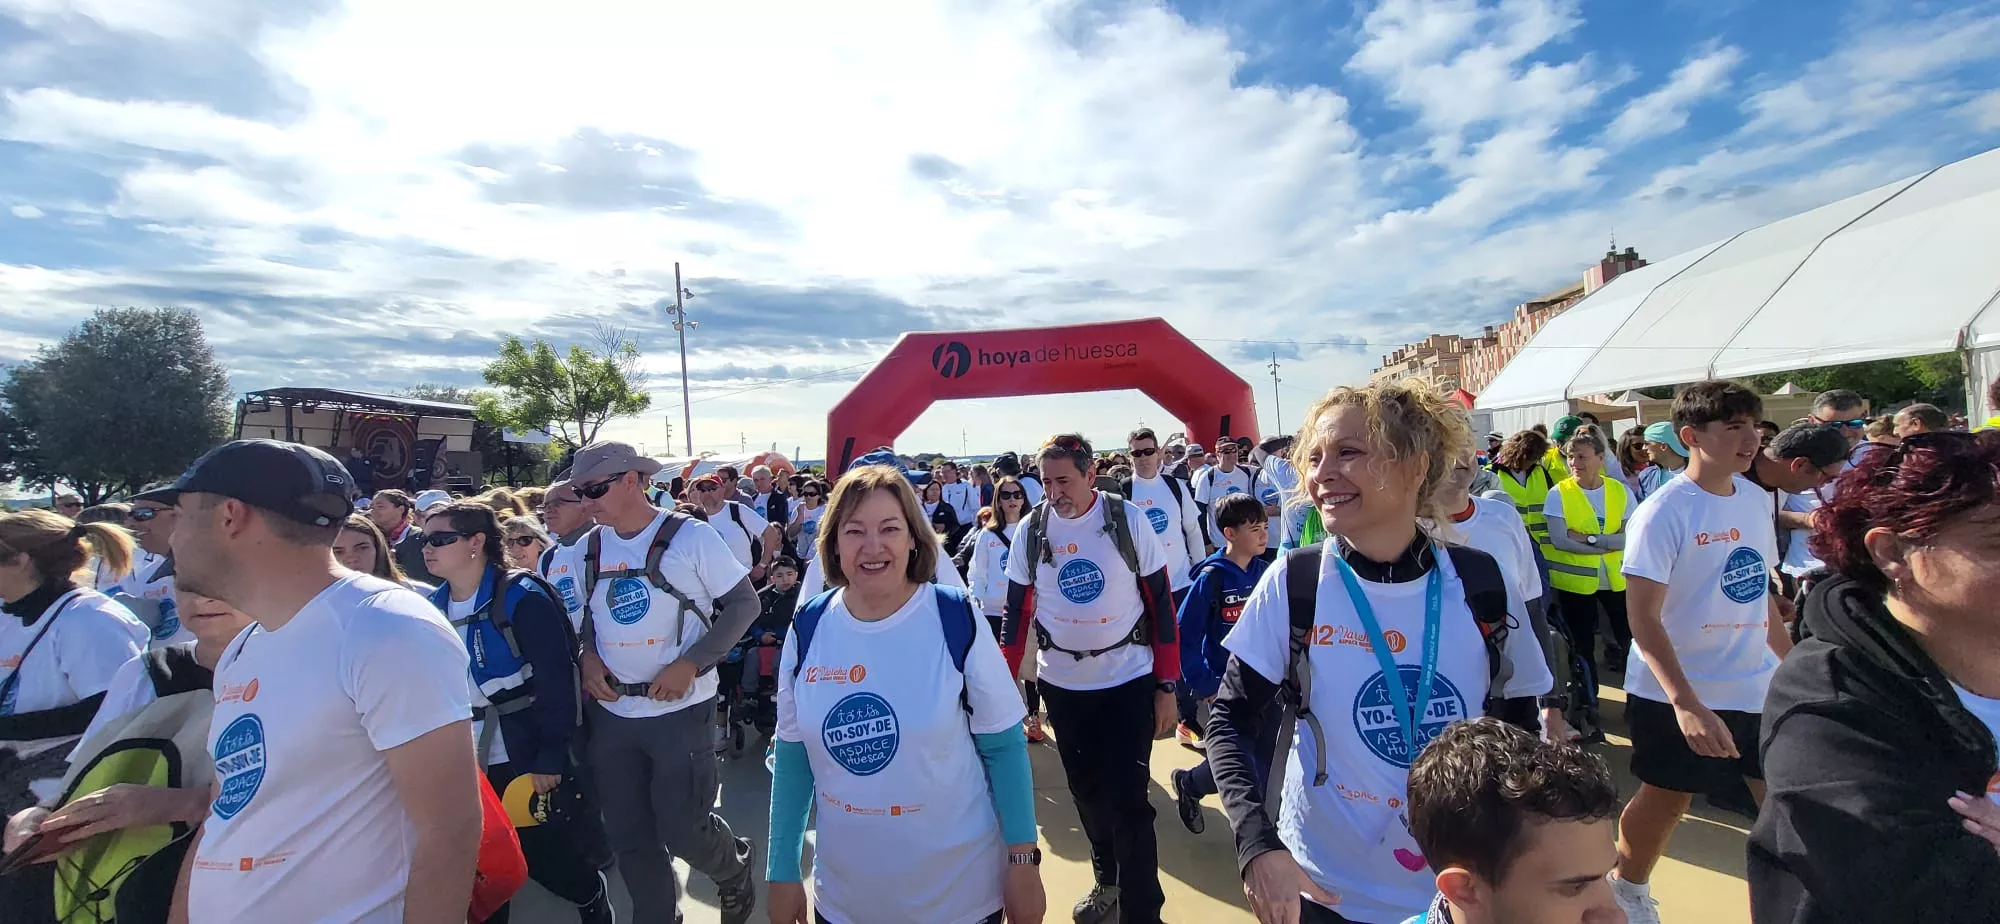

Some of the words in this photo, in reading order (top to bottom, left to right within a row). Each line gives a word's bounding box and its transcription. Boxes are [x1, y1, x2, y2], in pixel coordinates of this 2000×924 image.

[978, 348, 1030, 368] hoya
[1034, 345, 1060, 362] de
[1064, 342, 1137, 361] huesca
[1695, 532, 1710, 546] 12
[1311, 625, 1334, 646] 12
[805, 666, 818, 683] 12
[838, 738, 891, 759] ASPACE
